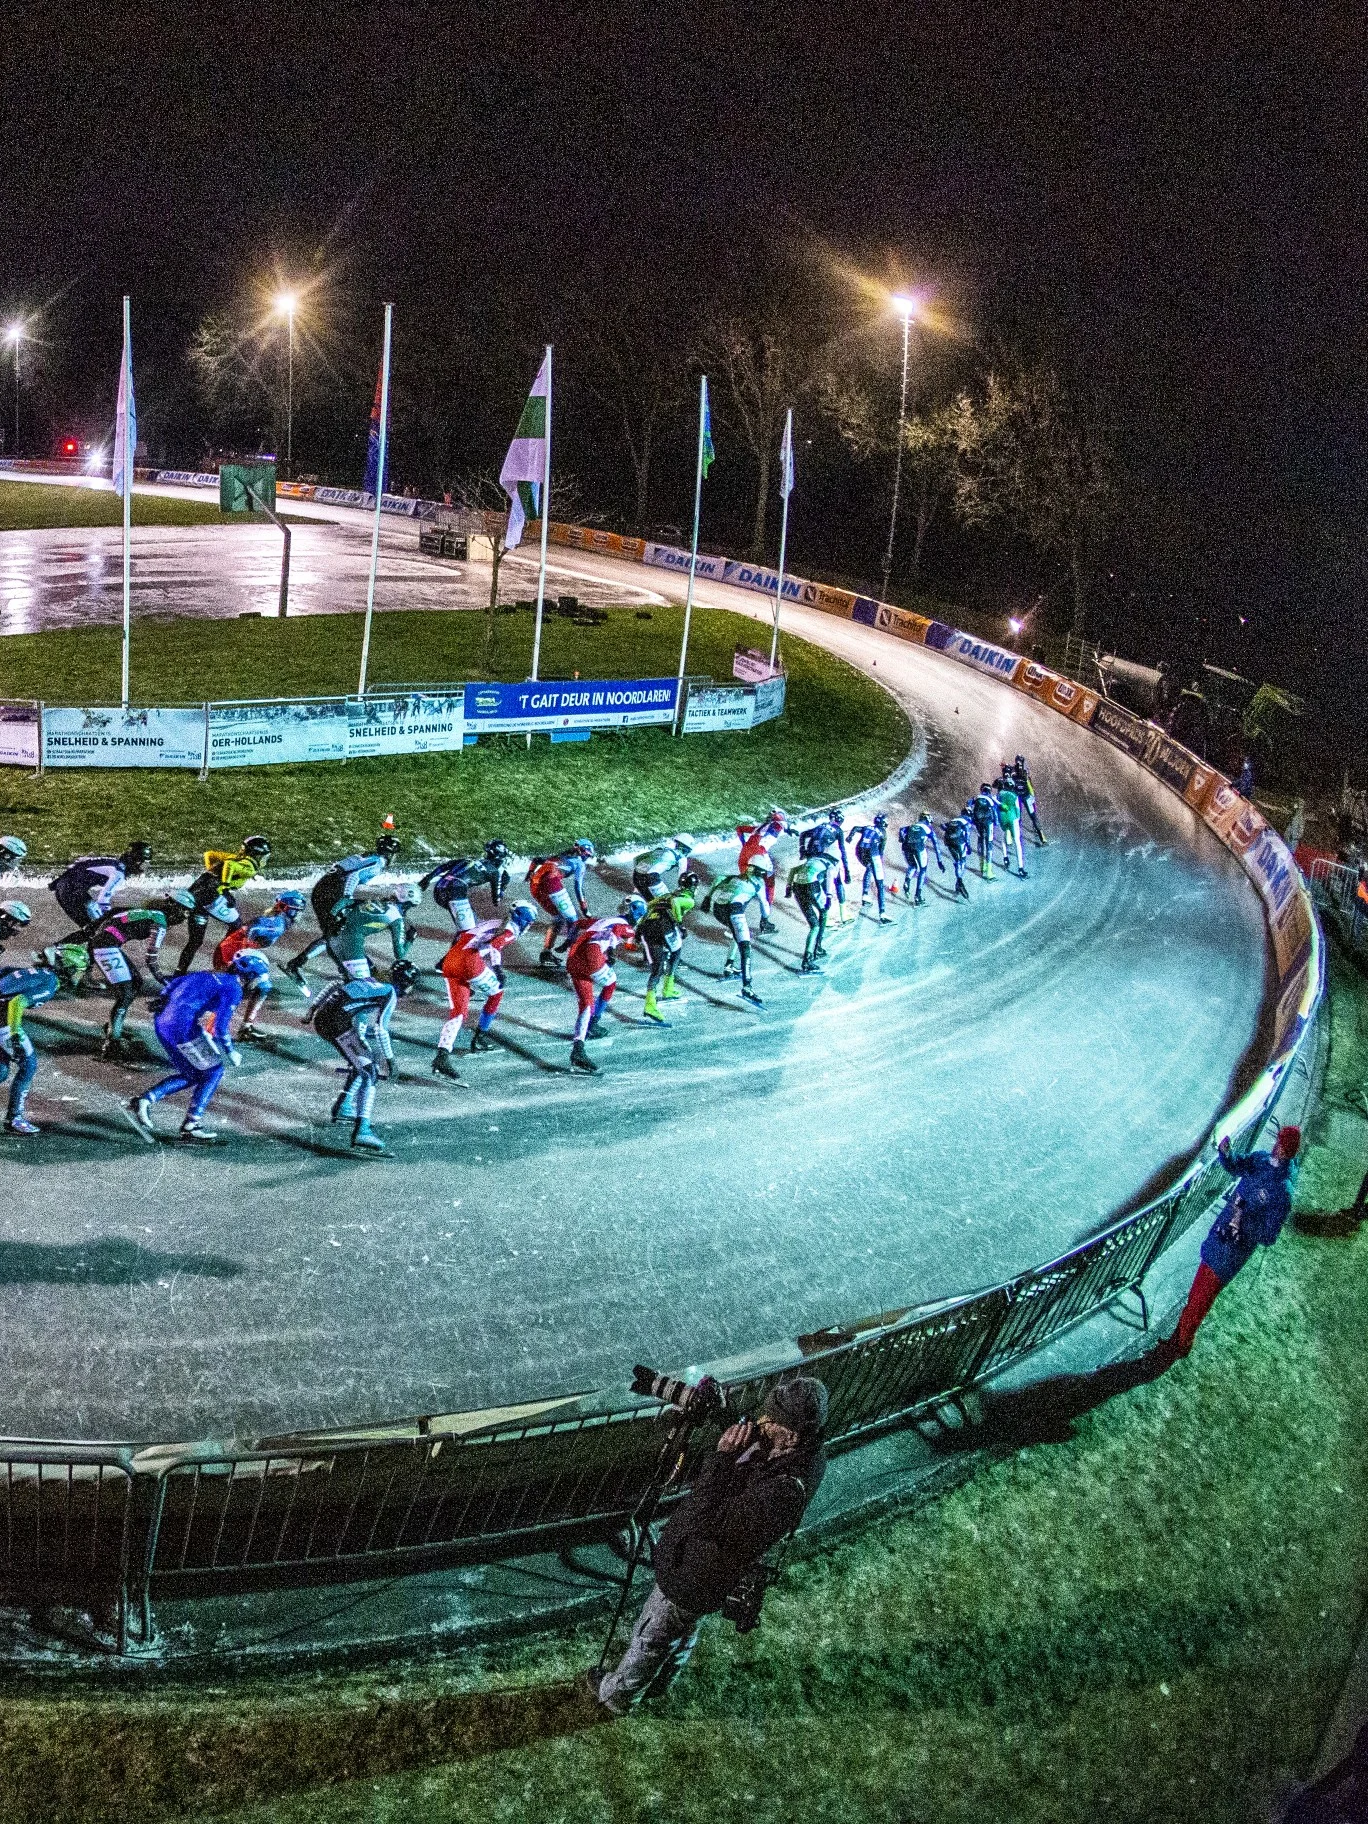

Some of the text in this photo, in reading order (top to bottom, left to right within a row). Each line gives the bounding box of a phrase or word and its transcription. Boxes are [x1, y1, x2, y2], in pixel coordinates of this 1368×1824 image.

[959, 638, 1017, 674] DAIKIN
[519, 689, 672, 709] 'T GAIT DEUR IN NOORDLAREN!
[688, 709, 711, 718] TACTIEK
[717, 707, 748, 717] TEAMWERK
[349, 726, 397, 738] SNELHEID
[399, 726, 405, 734] &
[407, 722, 453, 734] SPANNING
[47, 737, 165, 747] SNELHEID & SPANNING
[212, 735, 283, 748] OER-HOLLANDS
[100, 956, 125, 973] 52
